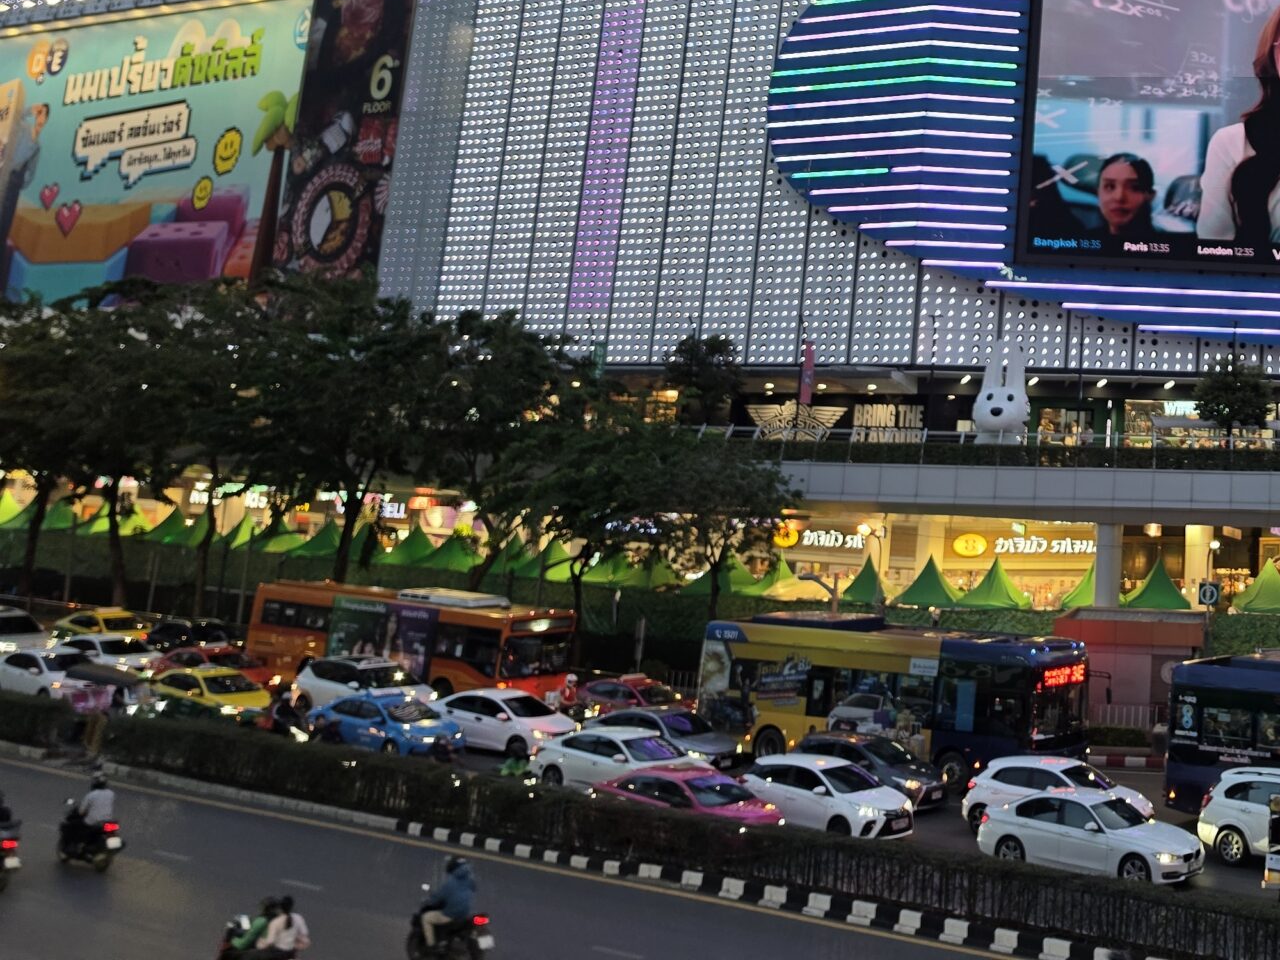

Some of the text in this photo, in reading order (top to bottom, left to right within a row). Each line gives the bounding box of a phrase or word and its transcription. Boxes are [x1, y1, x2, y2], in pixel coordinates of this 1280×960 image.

[362, 101, 392, 114] FLOOR
[1034, 237, 1077, 249] Bangkok
[1124, 242, 1148, 252] Paris
[1197, 246, 1233, 256] London
[853, 404, 924, 428] BRING THE
